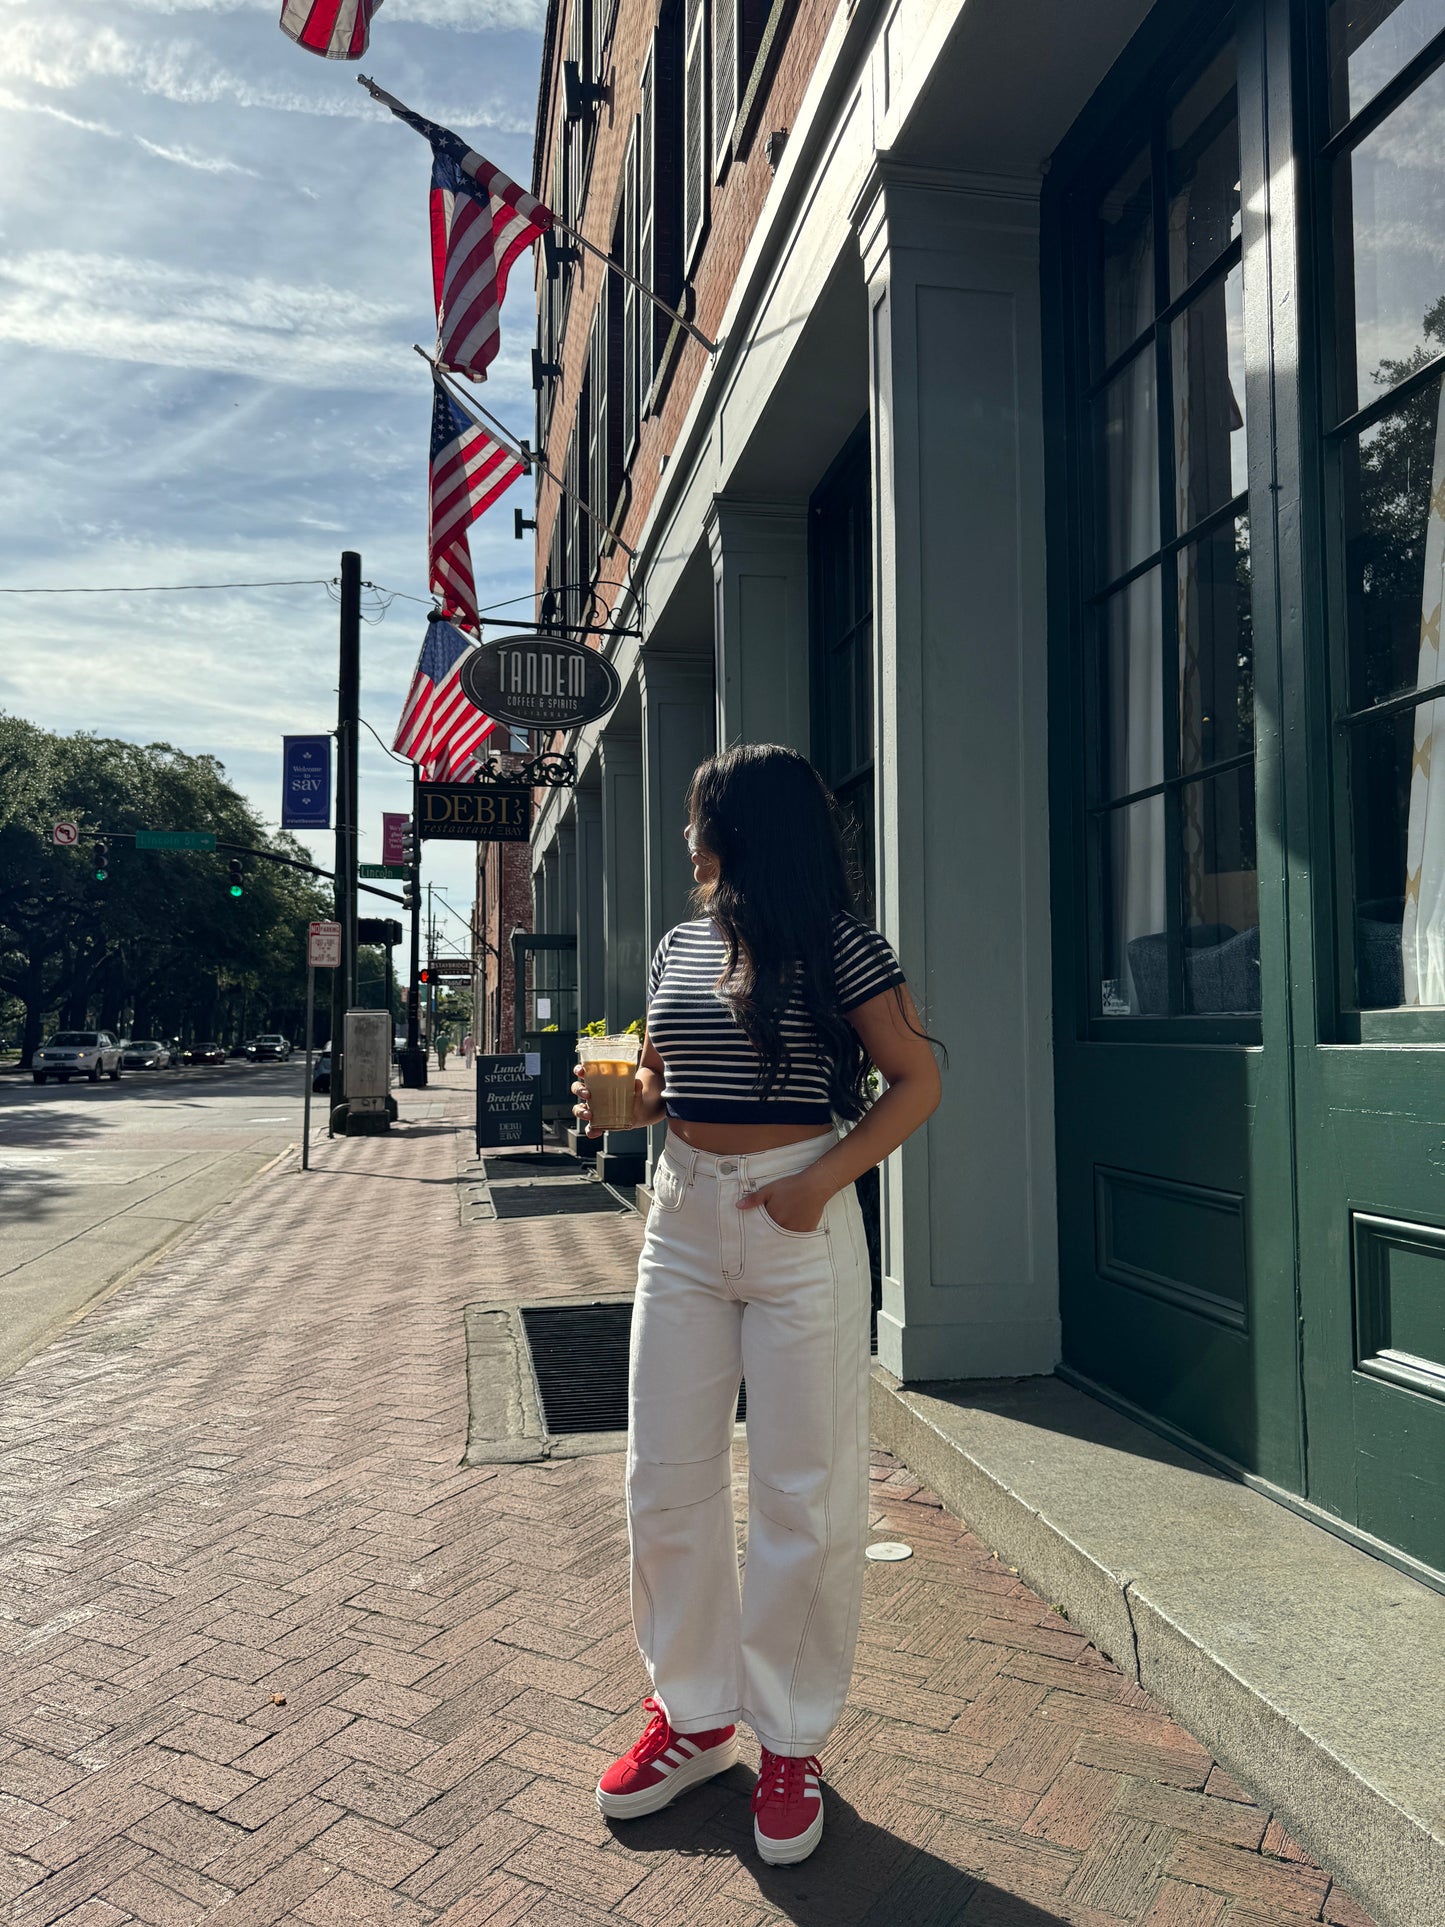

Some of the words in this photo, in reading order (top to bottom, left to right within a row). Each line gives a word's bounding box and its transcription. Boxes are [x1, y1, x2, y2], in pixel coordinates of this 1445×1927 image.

[497, 650, 585, 697] TANDEM
[507, 695, 536, 708] COFFEE
[539, 698, 545, 708] &
[548, 698, 578, 710] SPIRITS
[291, 779, 322, 791] sav
[423, 823, 495, 835] restaurant
[141, 835, 180, 845] Lincoln
[361, 866, 393, 878] Lincoln
[310, 924, 320, 933] NO
[493, 1062, 525, 1074] Lunch
[484, 1073, 534, 1083] SPECIALS
[486, 1091, 534, 1104] Breakfast
[488, 1103, 508, 1112] ALL
[511, 1102, 532, 1111] DAY
